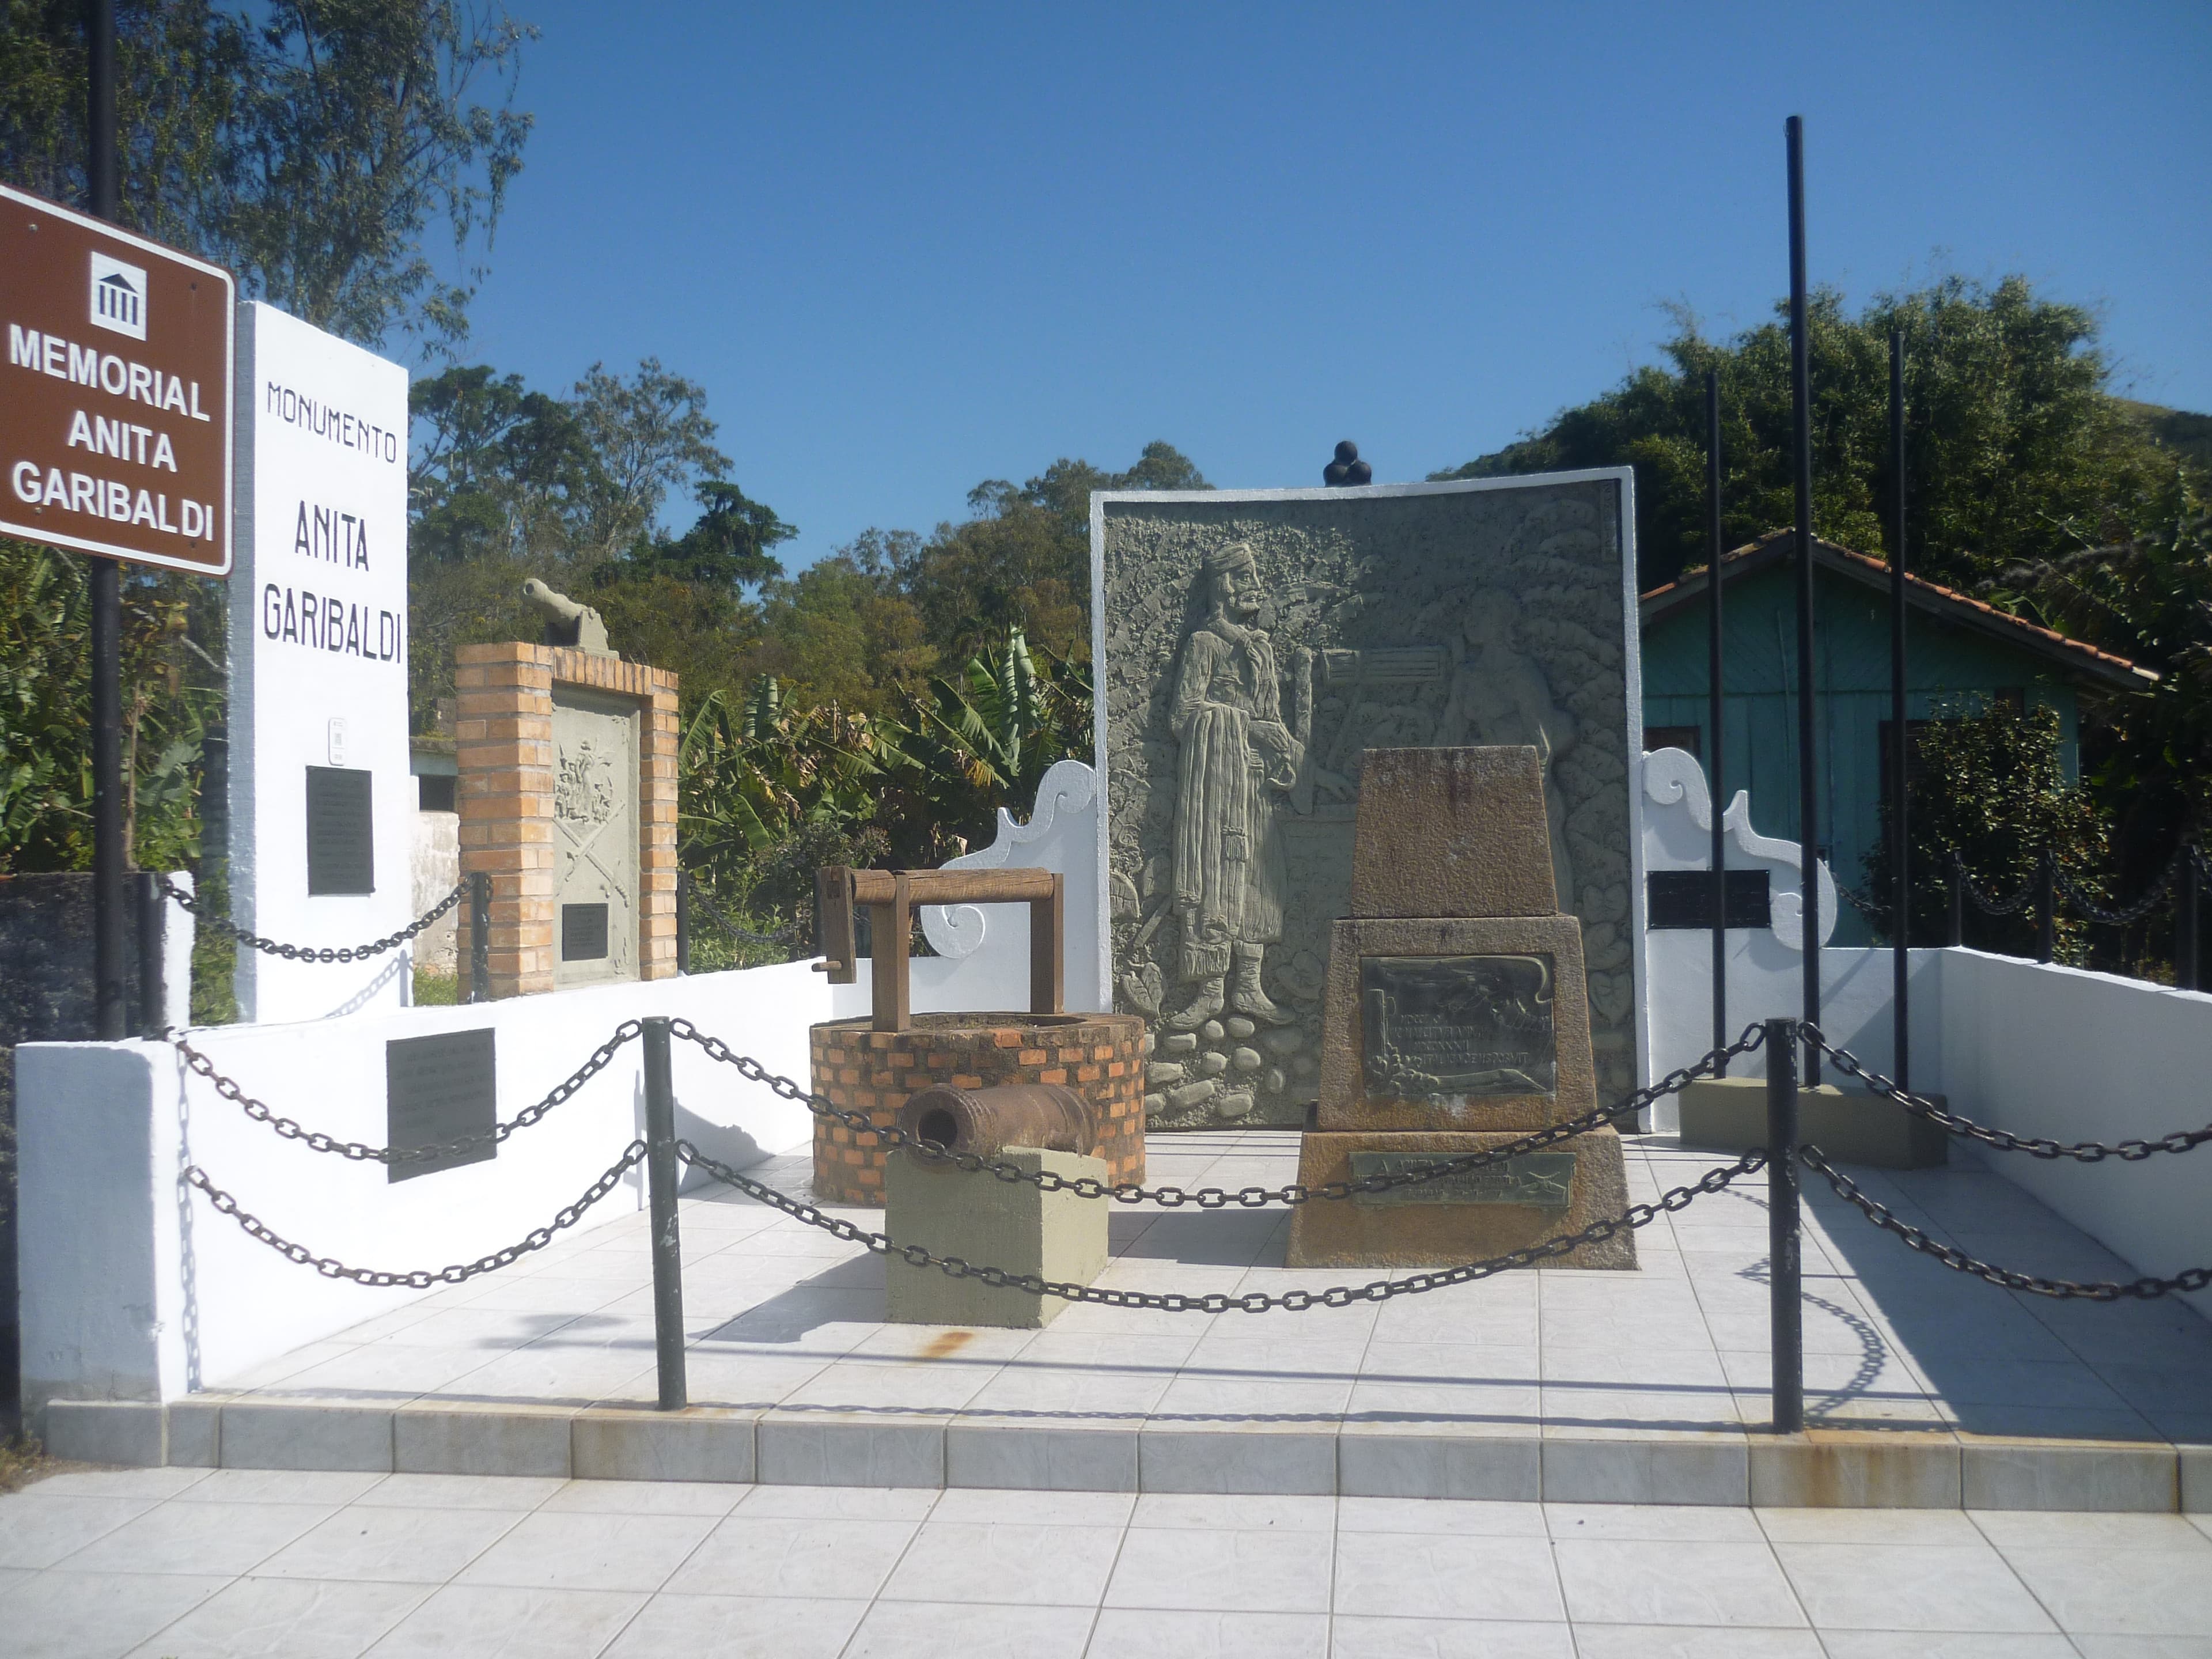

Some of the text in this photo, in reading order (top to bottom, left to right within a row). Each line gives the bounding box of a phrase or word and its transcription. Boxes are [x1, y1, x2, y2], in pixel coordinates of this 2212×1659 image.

[10, 323, 210, 422] MEMORIAL
[67, 410, 177, 472] ANITA
[268, 381, 396, 464] MONUMENTO
[12, 461, 214, 541] GARIBALDI
[294, 500, 369, 572] ANITA
[264, 583, 401, 664] GARIBALDI
